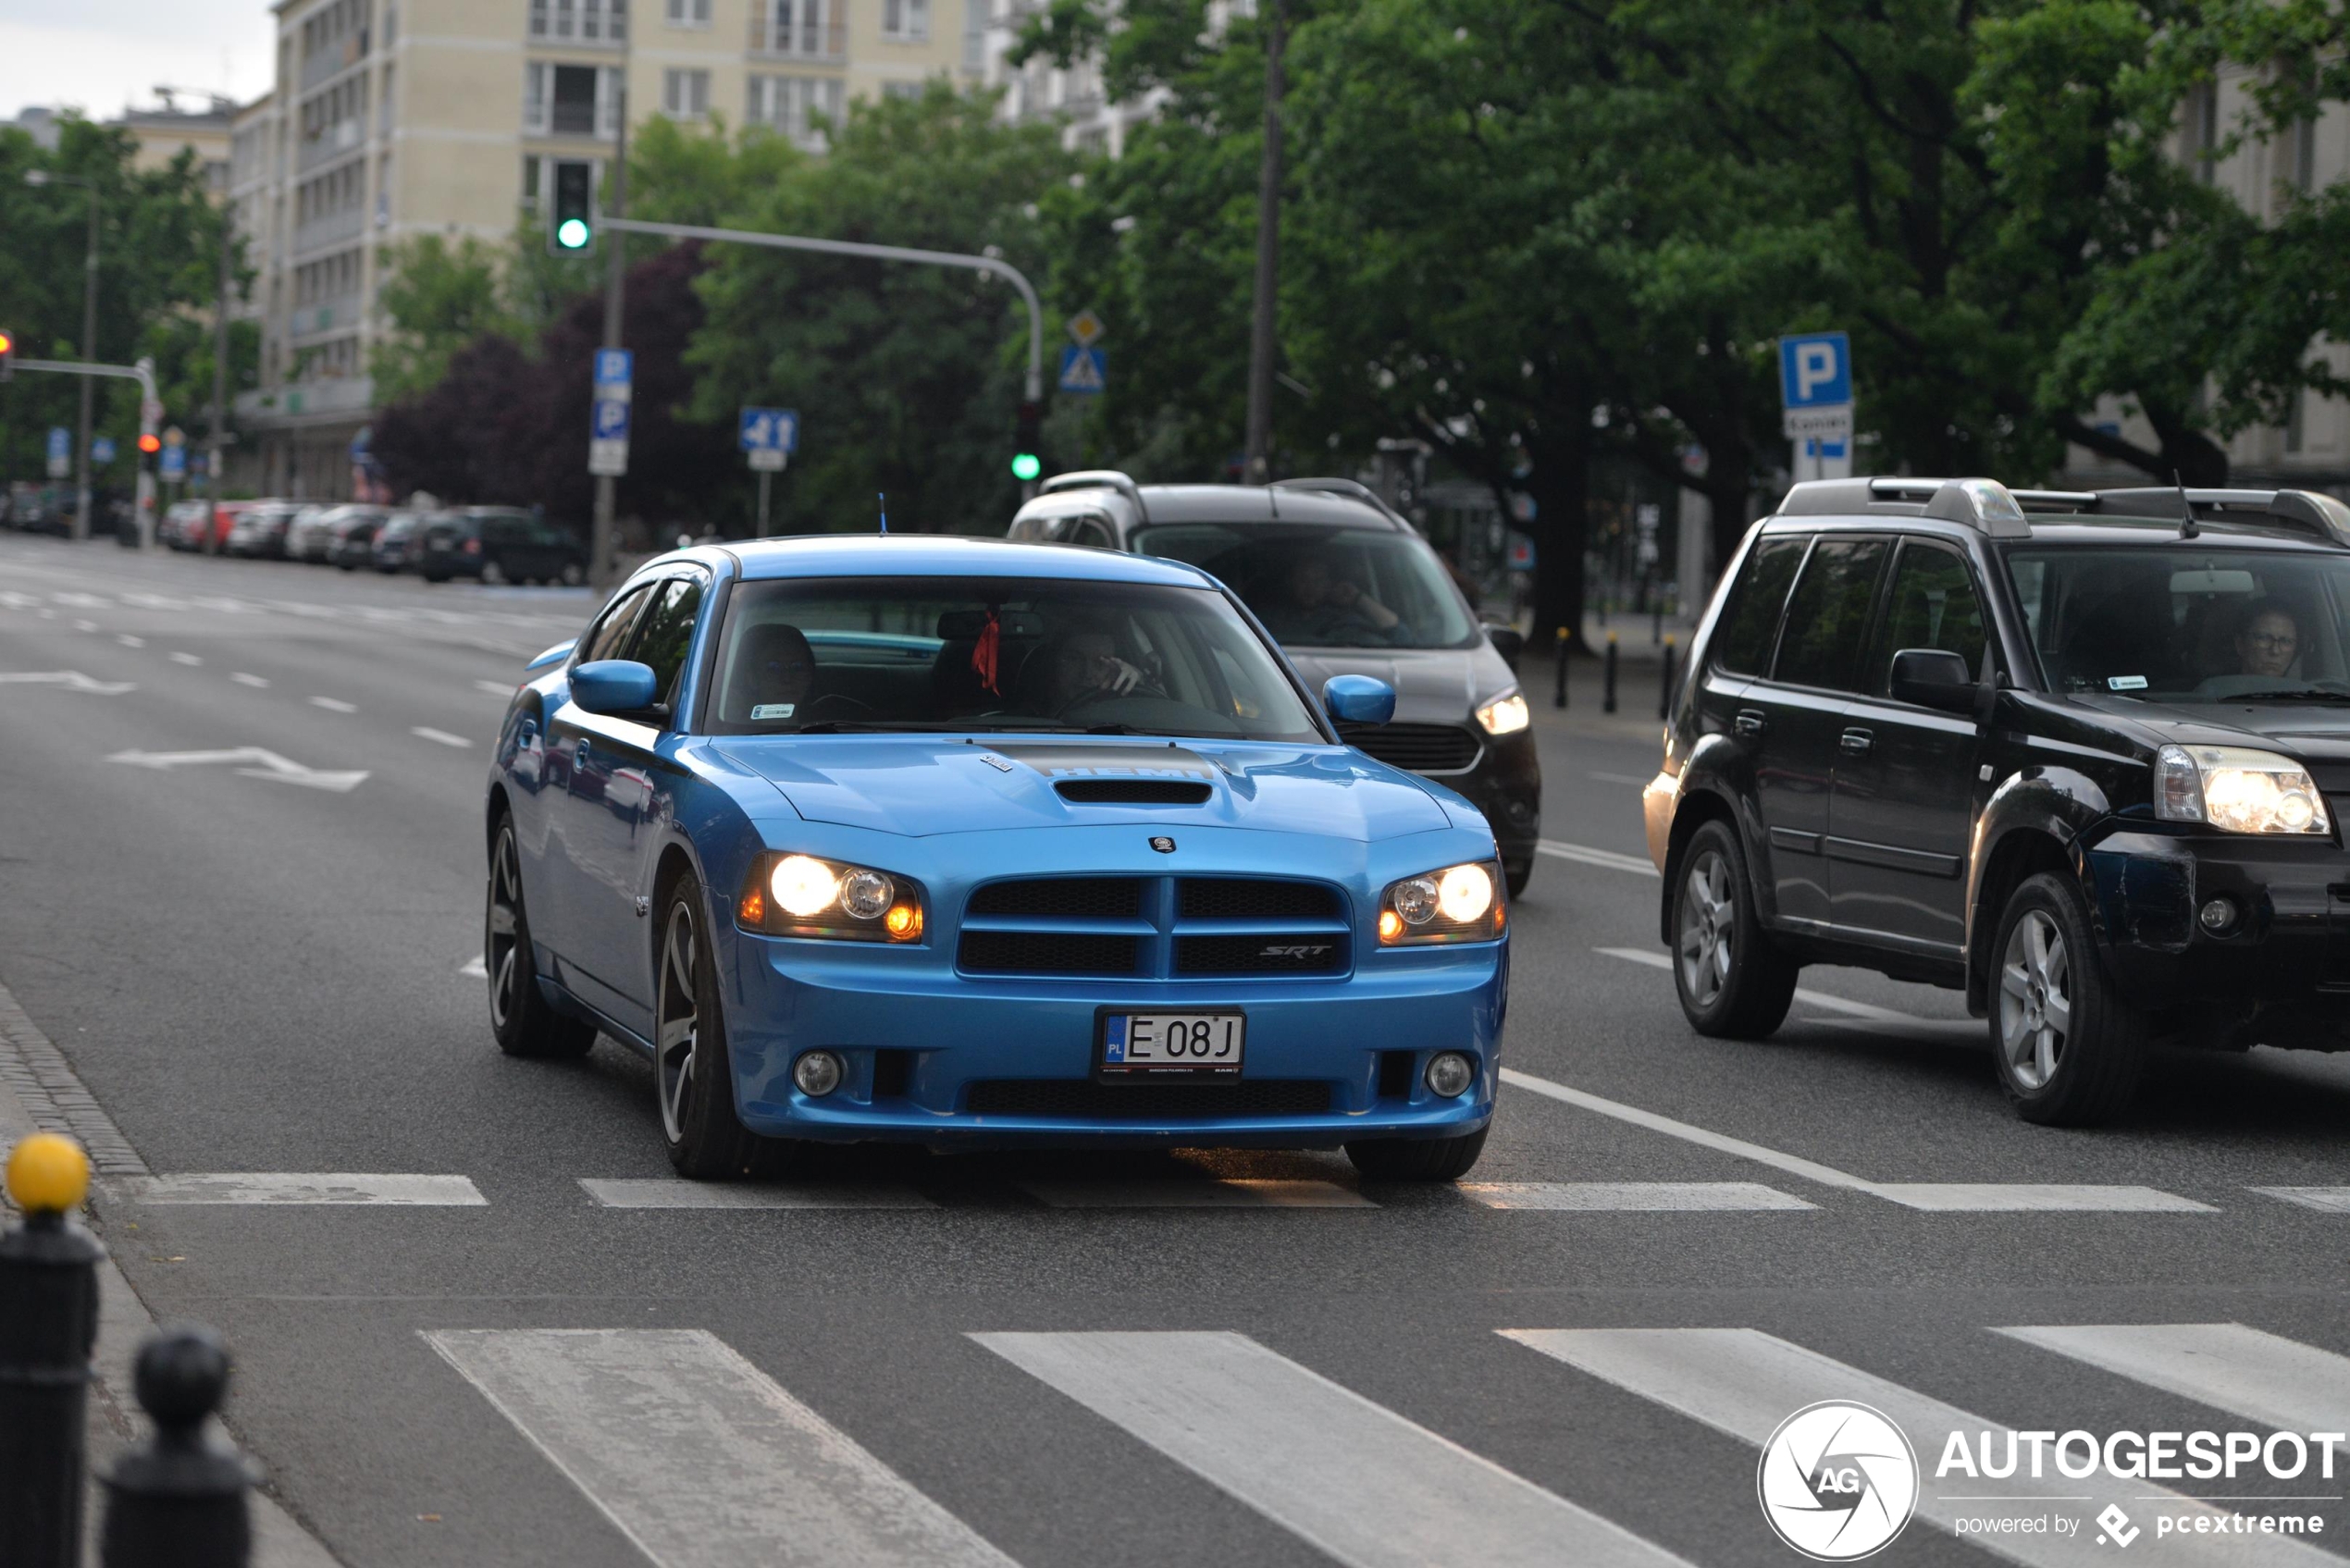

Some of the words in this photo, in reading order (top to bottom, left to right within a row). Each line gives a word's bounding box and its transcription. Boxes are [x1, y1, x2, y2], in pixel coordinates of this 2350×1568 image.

[1796, 342, 1837, 401] P
[1259, 945, 1332, 959] SRT
[1108, 1043, 1122, 1055] PL
[1129, 1020, 1154, 1057] E
[1167, 1020, 1232, 1057] 08J
